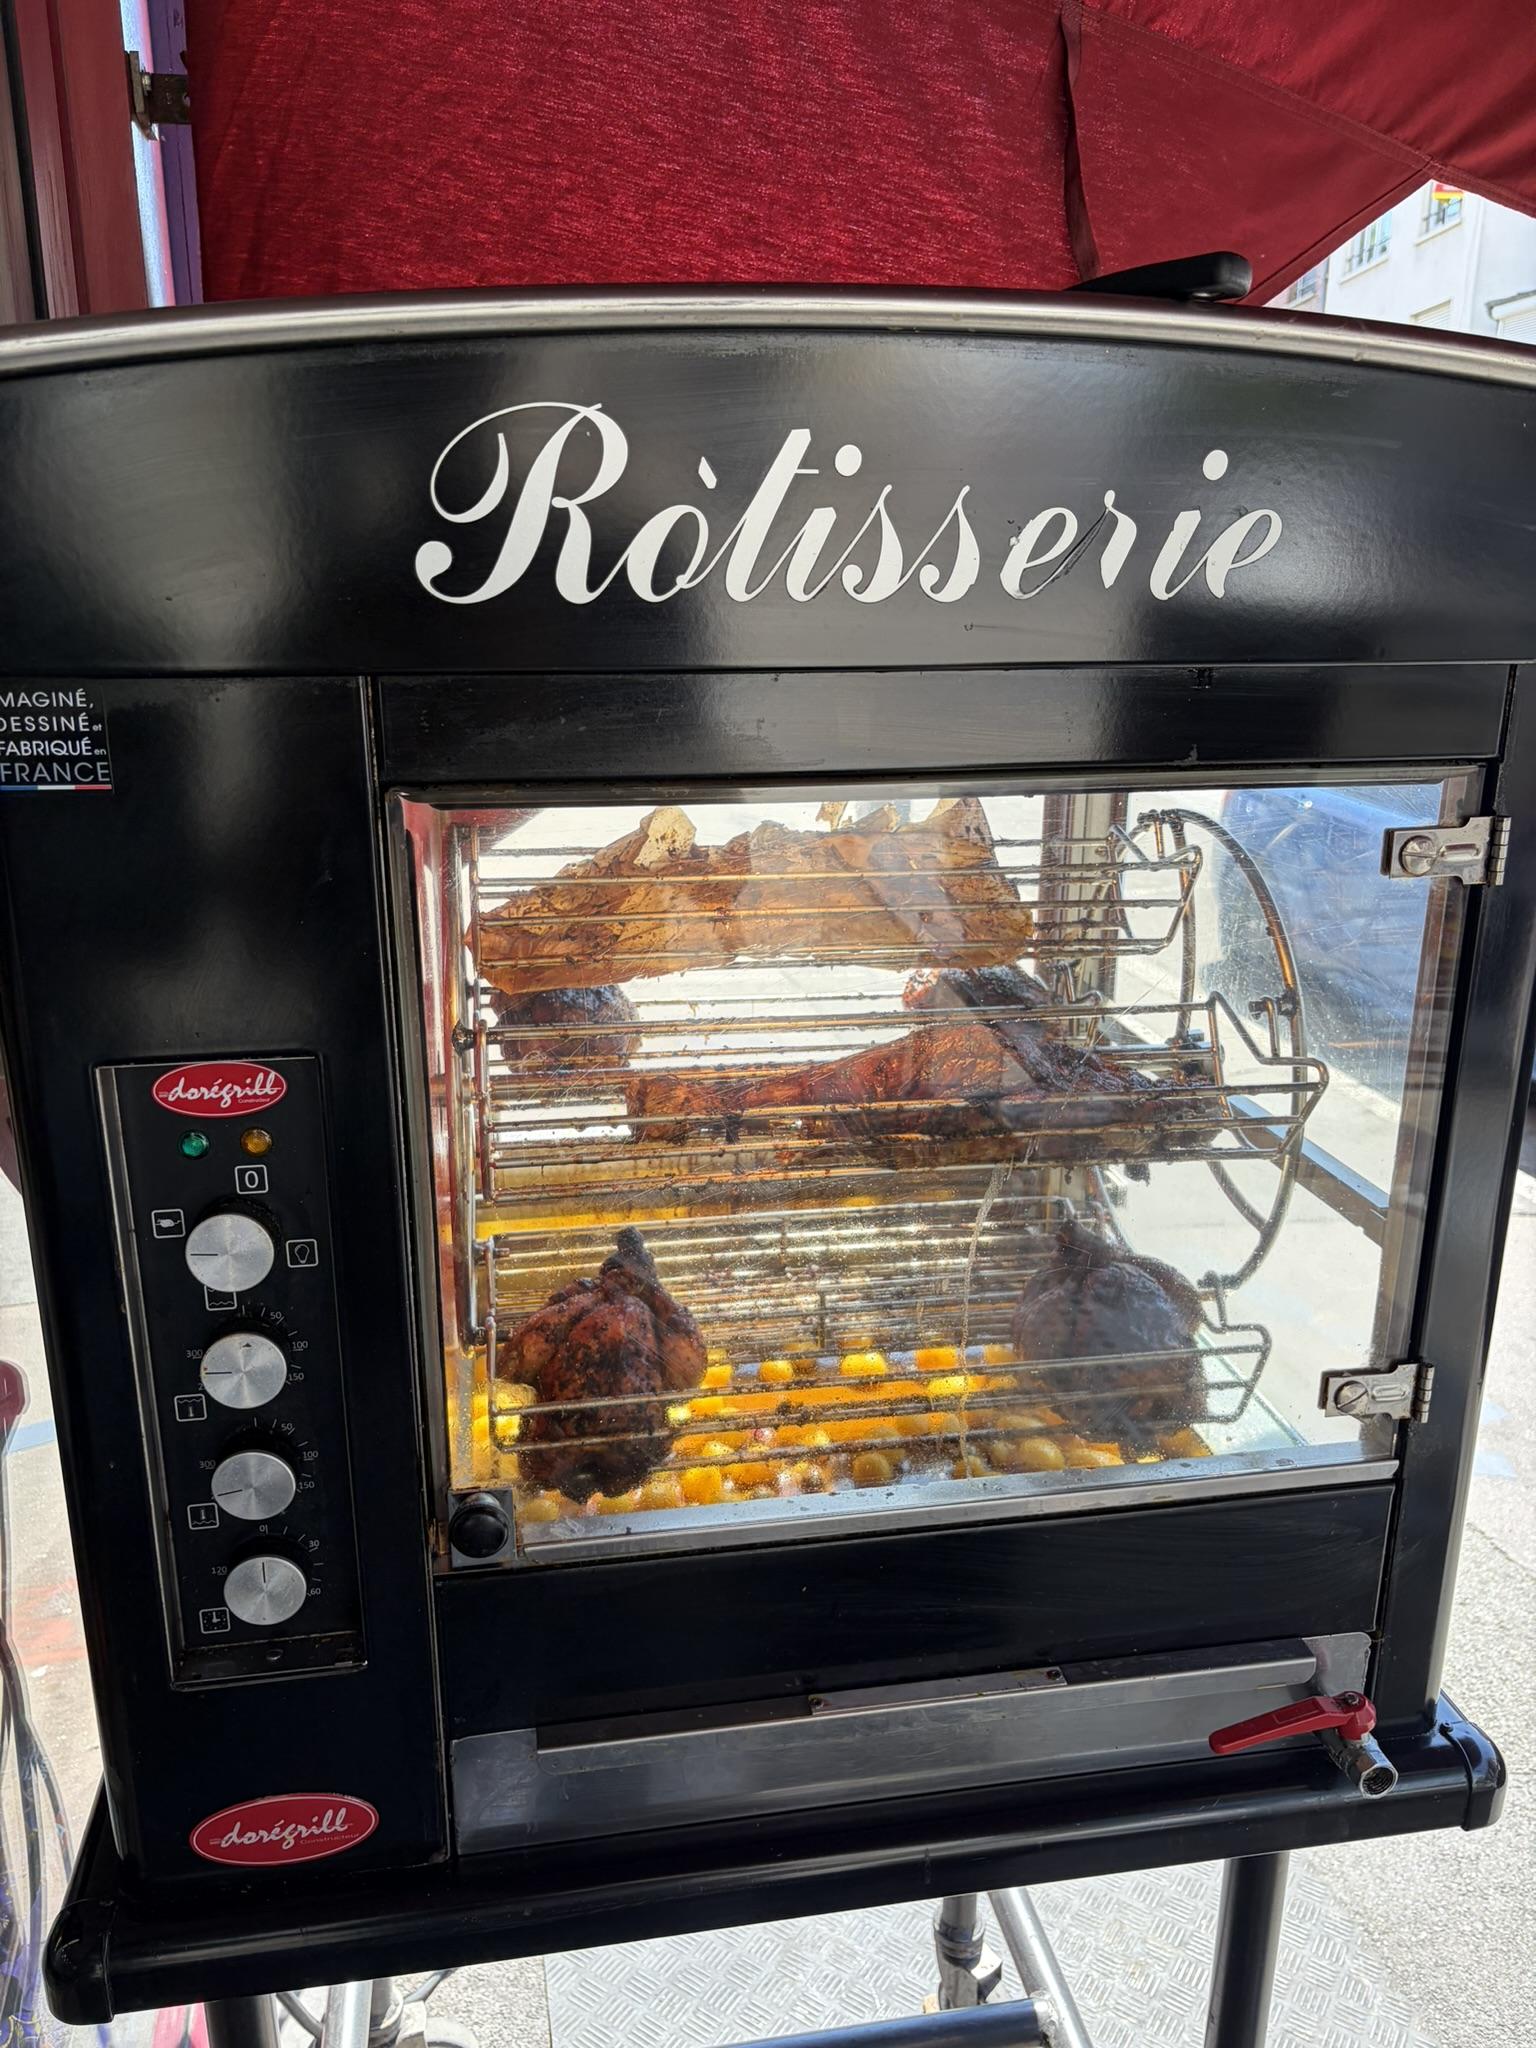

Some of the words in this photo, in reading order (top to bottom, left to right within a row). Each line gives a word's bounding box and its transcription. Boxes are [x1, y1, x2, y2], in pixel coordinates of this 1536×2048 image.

[92, 723, 102, 731] et
[0, 762, 110, 782] FRANCE
[168, 1072, 282, 1108] dorégrill
[270, 1311, 282, 1320] 50
[292, 1340, 308, 1349] 100
[288, 1373, 304, 1381] 150
[281, 1423, 293, 1431] 50
[303, 1451, 318, 1459] 100
[309, 1540, 320, 1548] 30
[310, 1588, 321, 1596] 60
[220, 1807, 353, 1850] dorégrill
